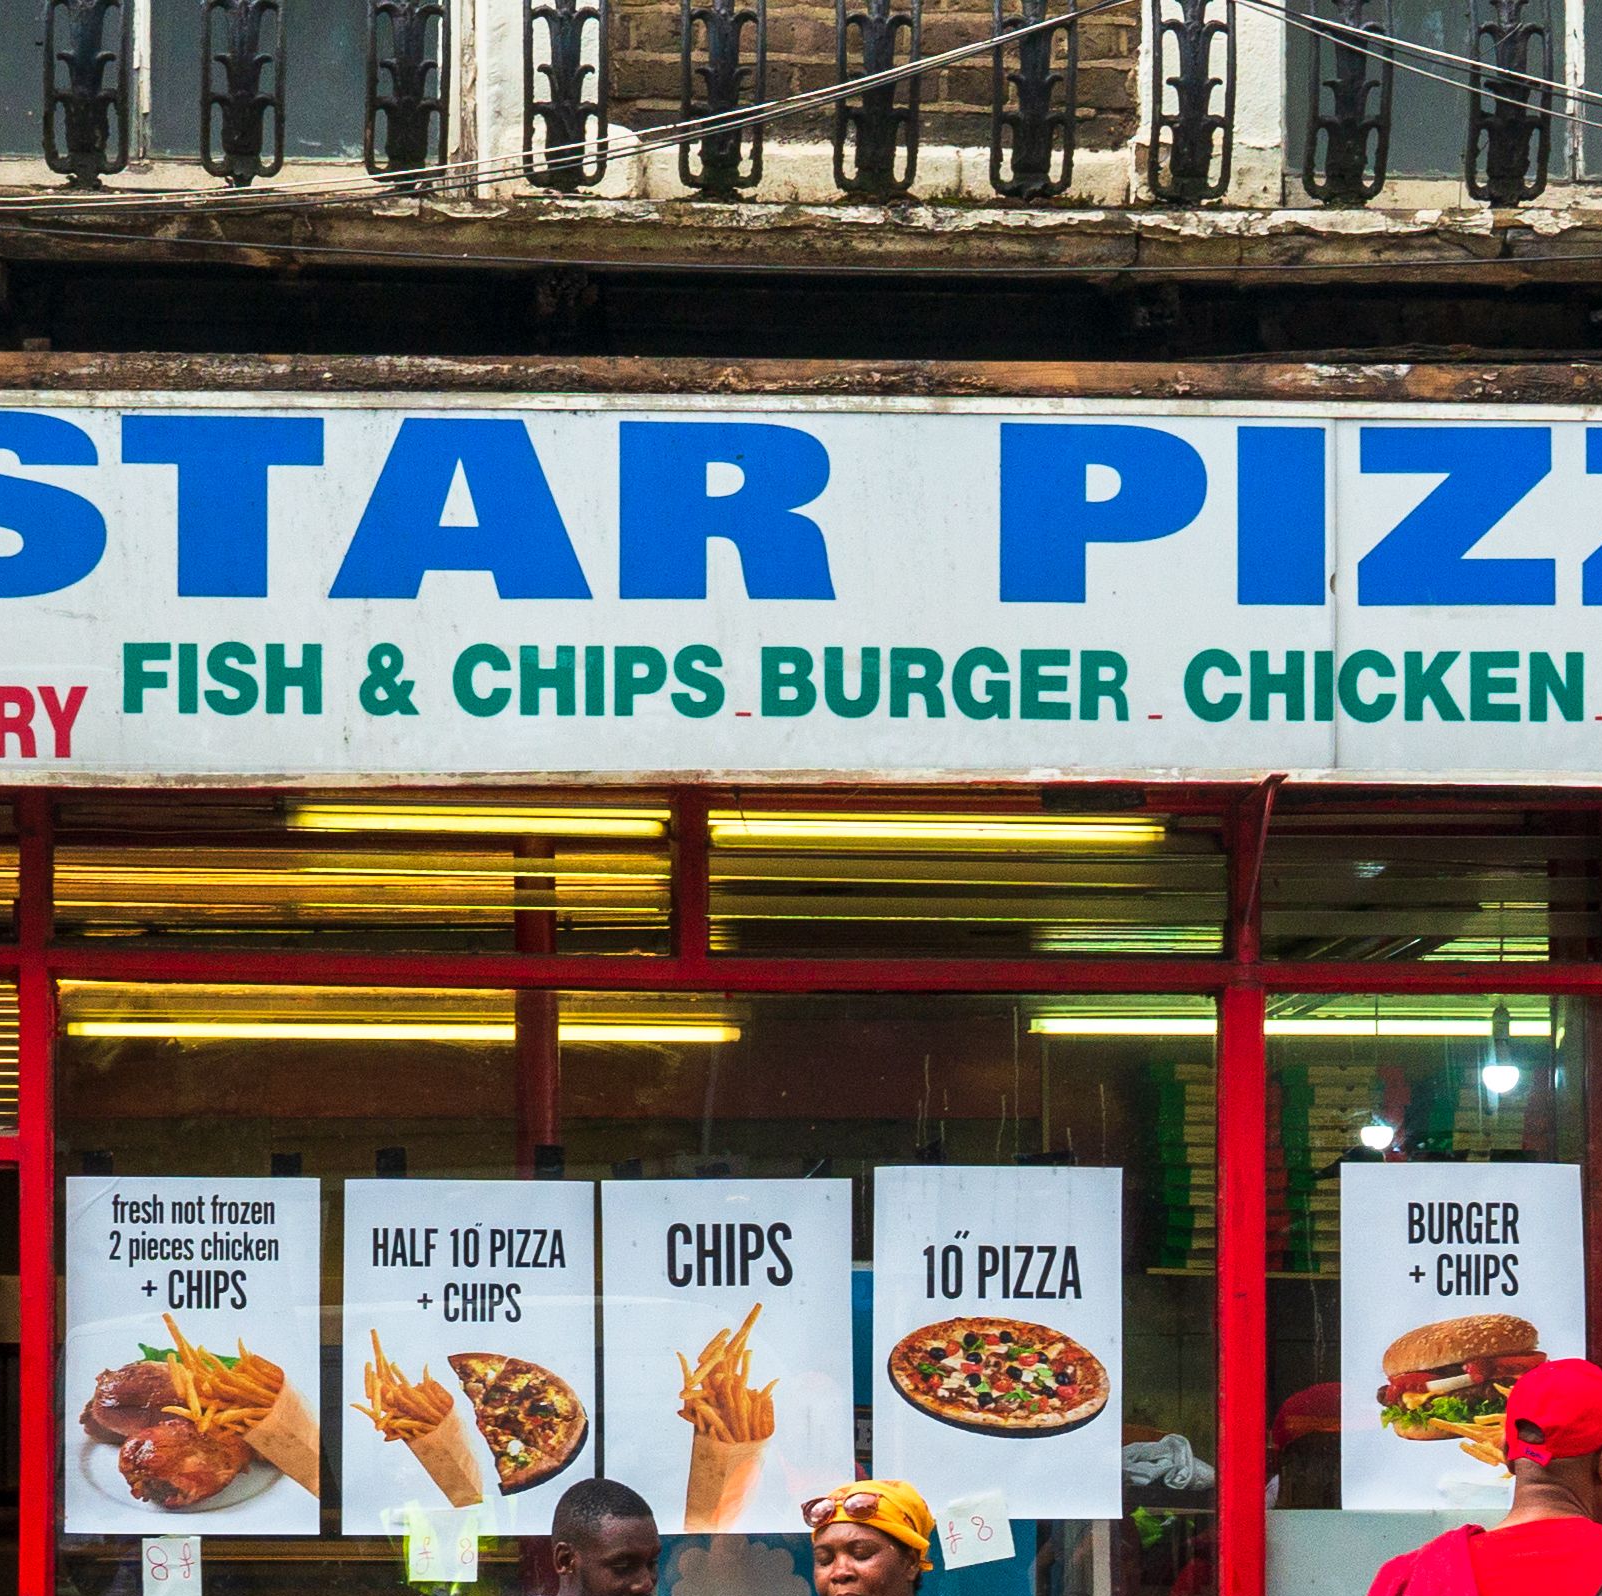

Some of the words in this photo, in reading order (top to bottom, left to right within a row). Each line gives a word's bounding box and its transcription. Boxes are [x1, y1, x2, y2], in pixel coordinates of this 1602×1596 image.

[123, 642, 322, 716] FISH
[359, 643, 419, 716] &
[453, 643, 725, 718] CHIPS
[761, 647, 1129, 721] BURGER
[1184, 649, 1584, 723] CHICKEN
[112, 1194, 163, 1225] fresh
[172, 1196, 205, 1224] not
[211, 1195, 275, 1225] frozen
[1408, 1202, 1520, 1245] BURGER
[110, 1231, 121, 1260] 2
[130, 1231, 194, 1268] pieces
[202, 1232, 279, 1261] chicken
[373, 1228, 438, 1267] HALF
[490, 1229, 566, 1268] PIZZA
[667, 1222, 793, 1288] CHIPS
[141, 1280, 158, 1298] +
[168, 1270, 247, 1309] CHIPS
[978, 1246, 1082, 1300] PIZZA
[1409, 1265, 1426, 1283] +
[1436, 1254, 1519, 1297] CHIPS
[417, 1293, 433, 1310] +
[444, 1283, 522, 1322] CHIPS
